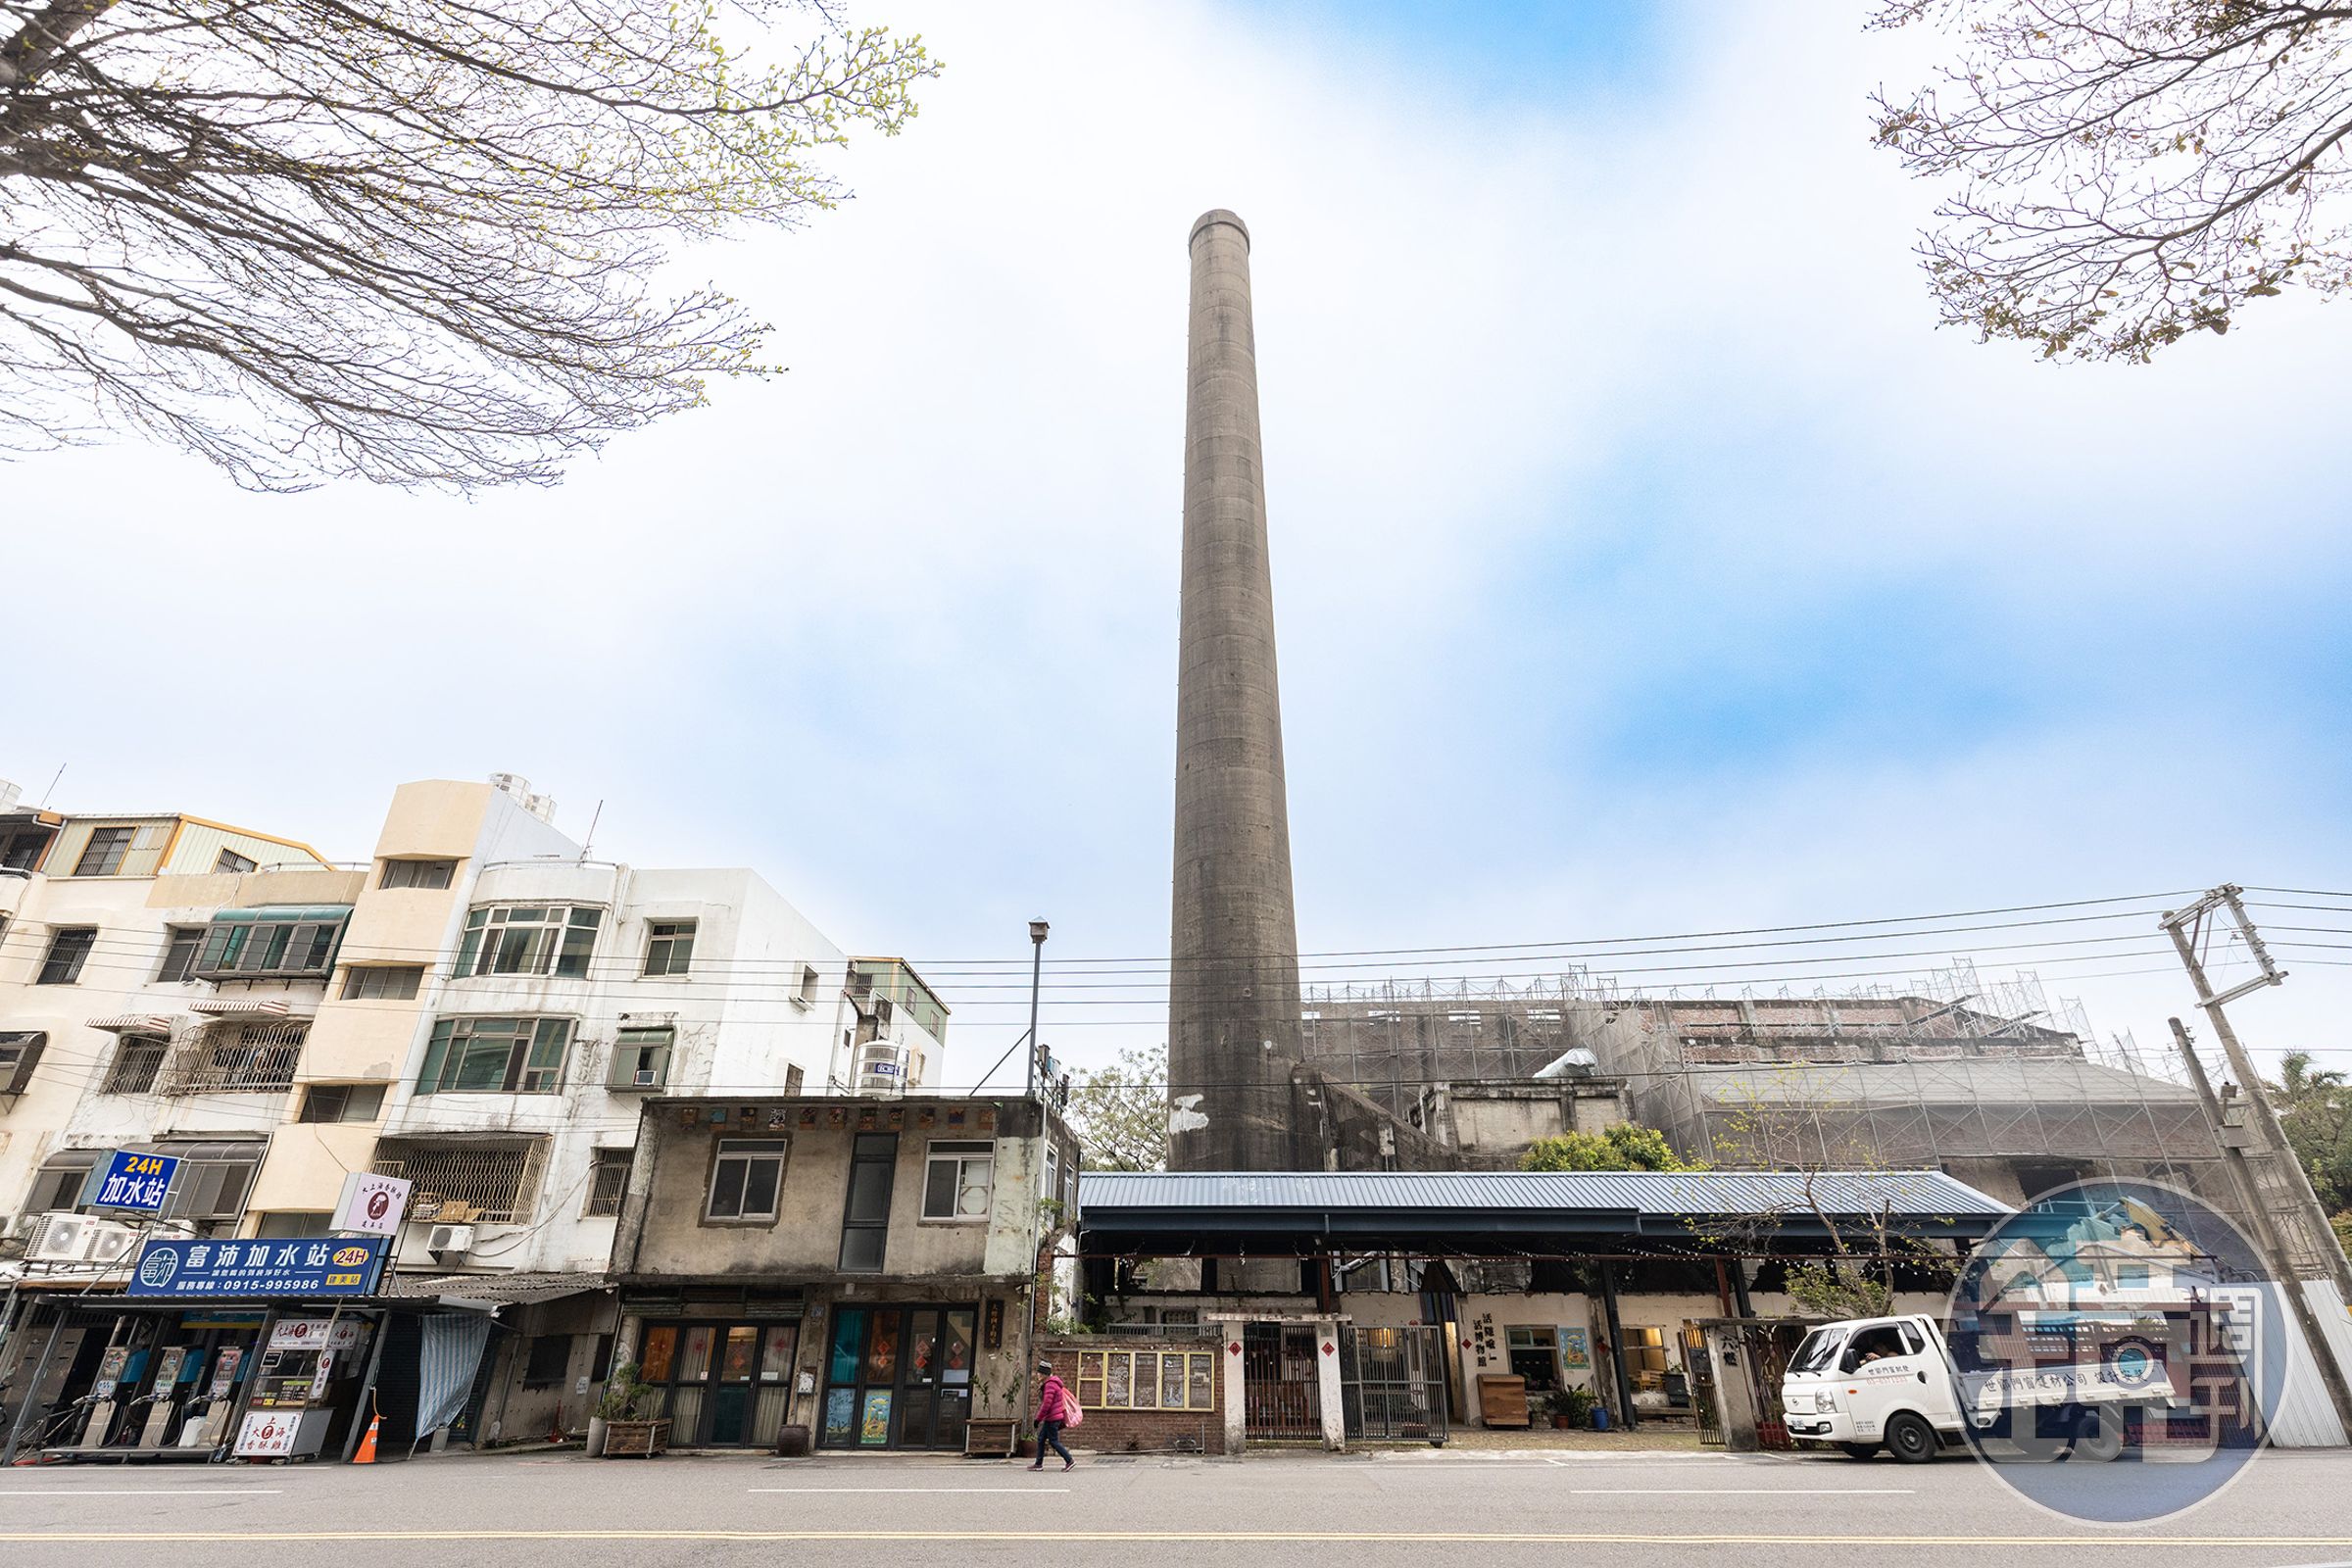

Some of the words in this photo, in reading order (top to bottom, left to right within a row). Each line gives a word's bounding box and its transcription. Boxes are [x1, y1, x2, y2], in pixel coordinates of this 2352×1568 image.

[124, 1156, 164, 1175] 24H
[100, 1173, 166, 1206] 加水站
[184, 1244, 330, 1268] 富沛加水站
[335, 1249, 368, 1264] 24H
